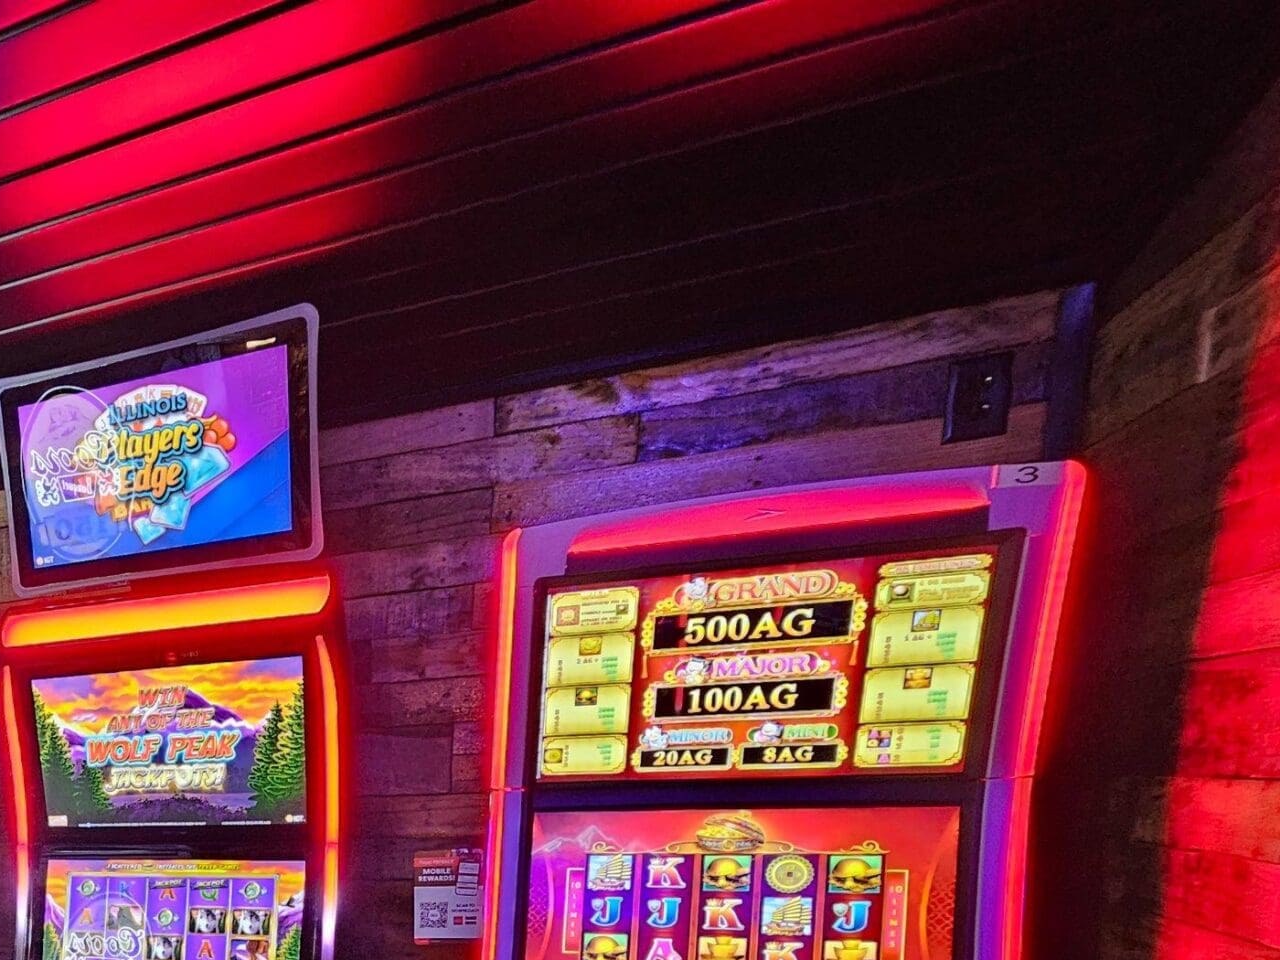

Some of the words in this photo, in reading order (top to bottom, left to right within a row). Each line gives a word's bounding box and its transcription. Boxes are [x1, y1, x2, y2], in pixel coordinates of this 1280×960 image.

[108, 392, 187, 425] ILLINOIS
[100, 422, 200, 465] Players
[117, 461, 184, 499] Edge
[1015, 466, 1040, 484] 3
[711, 574, 827, 603] GRAND
[684, 607, 817, 644] 500AG
[711, 655, 812, 677] MAJOR
[138, 686, 188, 709] WIN
[688, 683, 799, 713] 100AG
[108, 713, 145, 733] ANY
[147, 711, 172, 731] OF
[176, 708, 215, 728] THE
[87, 736, 160, 767] WOLF
[168, 730, 240, 760] PEAK
[653, 749, 713, 766] 20AG
[762, 746, 814, 763] 8AG
[645, 855, 687, 889] K
[590, 897, 624, 927] J
[647, 898, 682, 928] J
[702, 897, 745, 930] K
[832, 900, 872, 933] J
[196, 939, 215, 960] A
